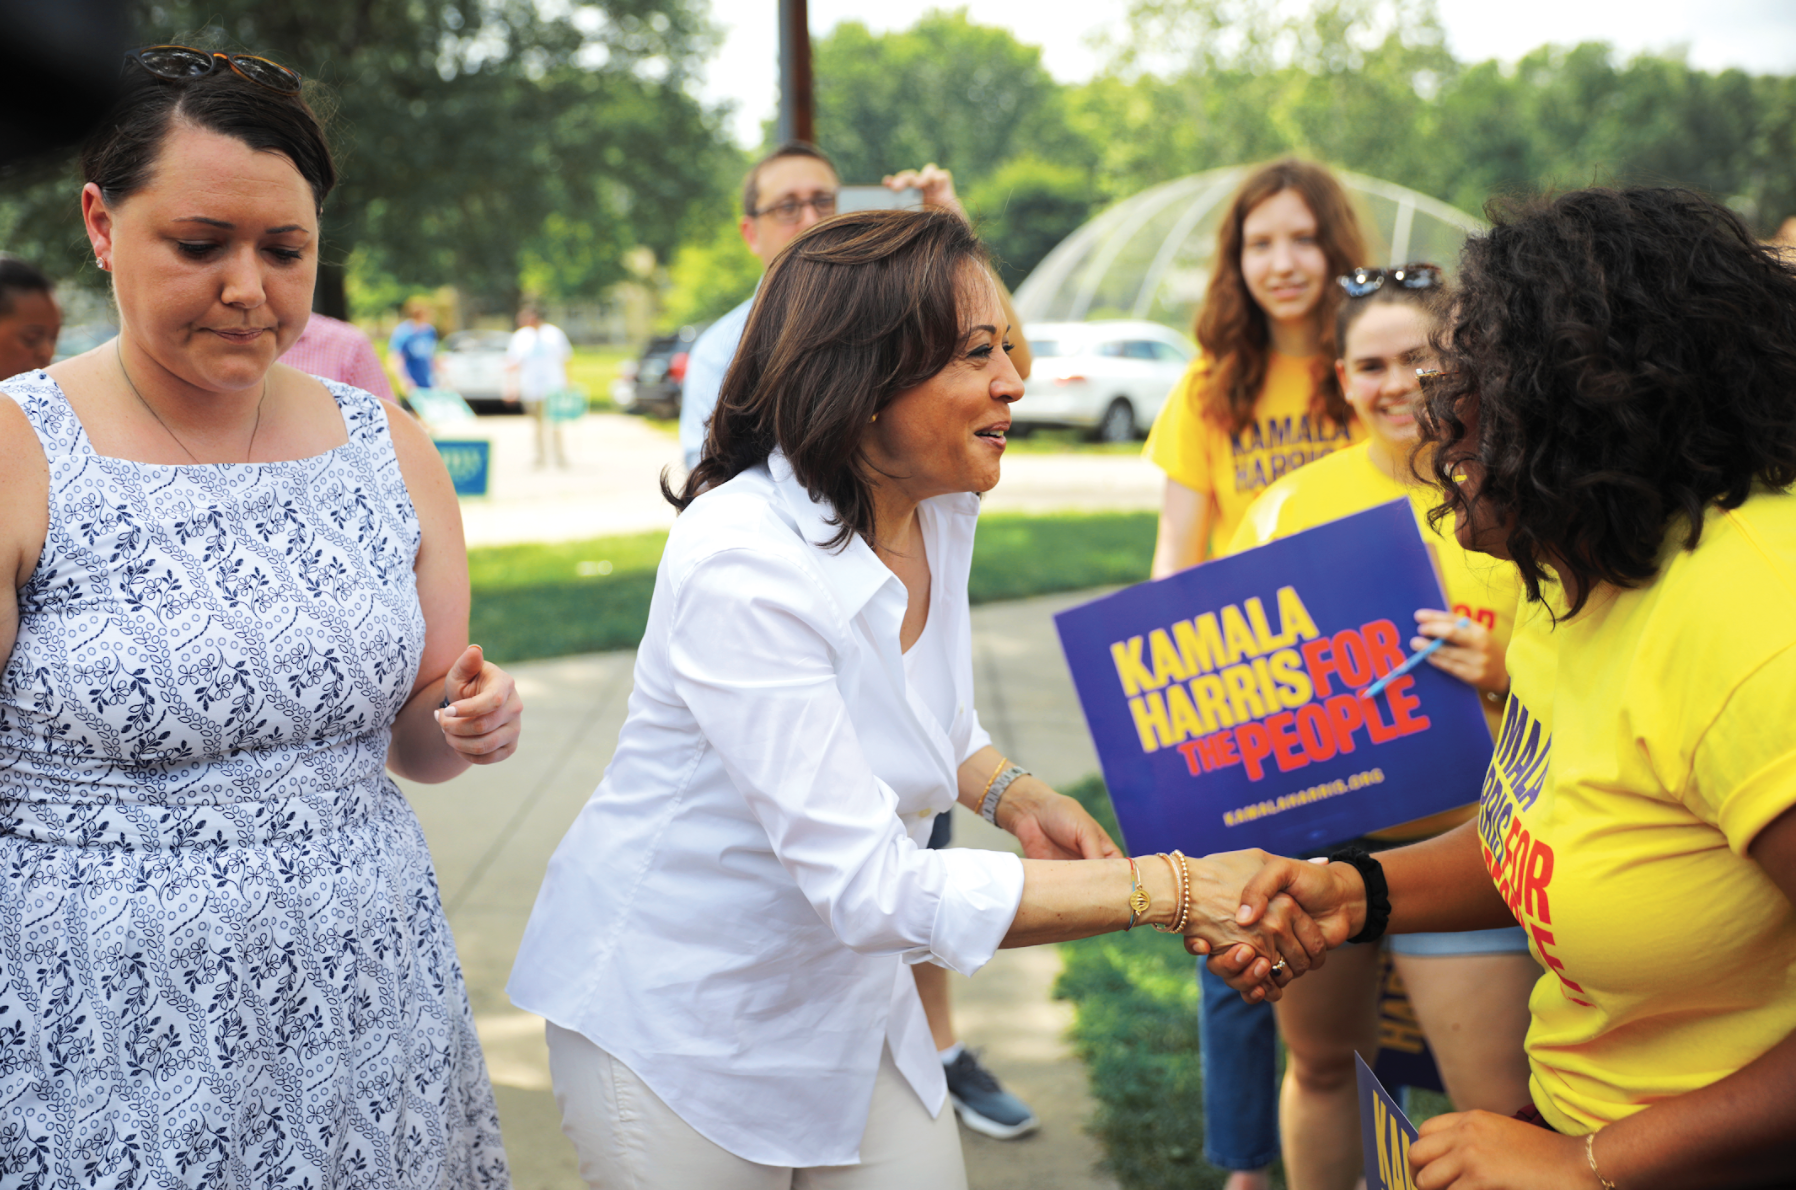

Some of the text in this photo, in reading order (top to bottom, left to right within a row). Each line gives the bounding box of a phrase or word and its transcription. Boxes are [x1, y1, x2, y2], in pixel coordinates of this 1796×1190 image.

[1110, 585, 1320, 698] KAMALA
[1128, 618, 1408, 753] HARRIS FOR
[1177, 674, 1431, 781] THE PEOPLE
[1497, 691, 1552, 813] MALA
[1223, 767, 1385, 827] KAMALAHARRIS.ORG
[1502, 815, 1554, 925] FOR
